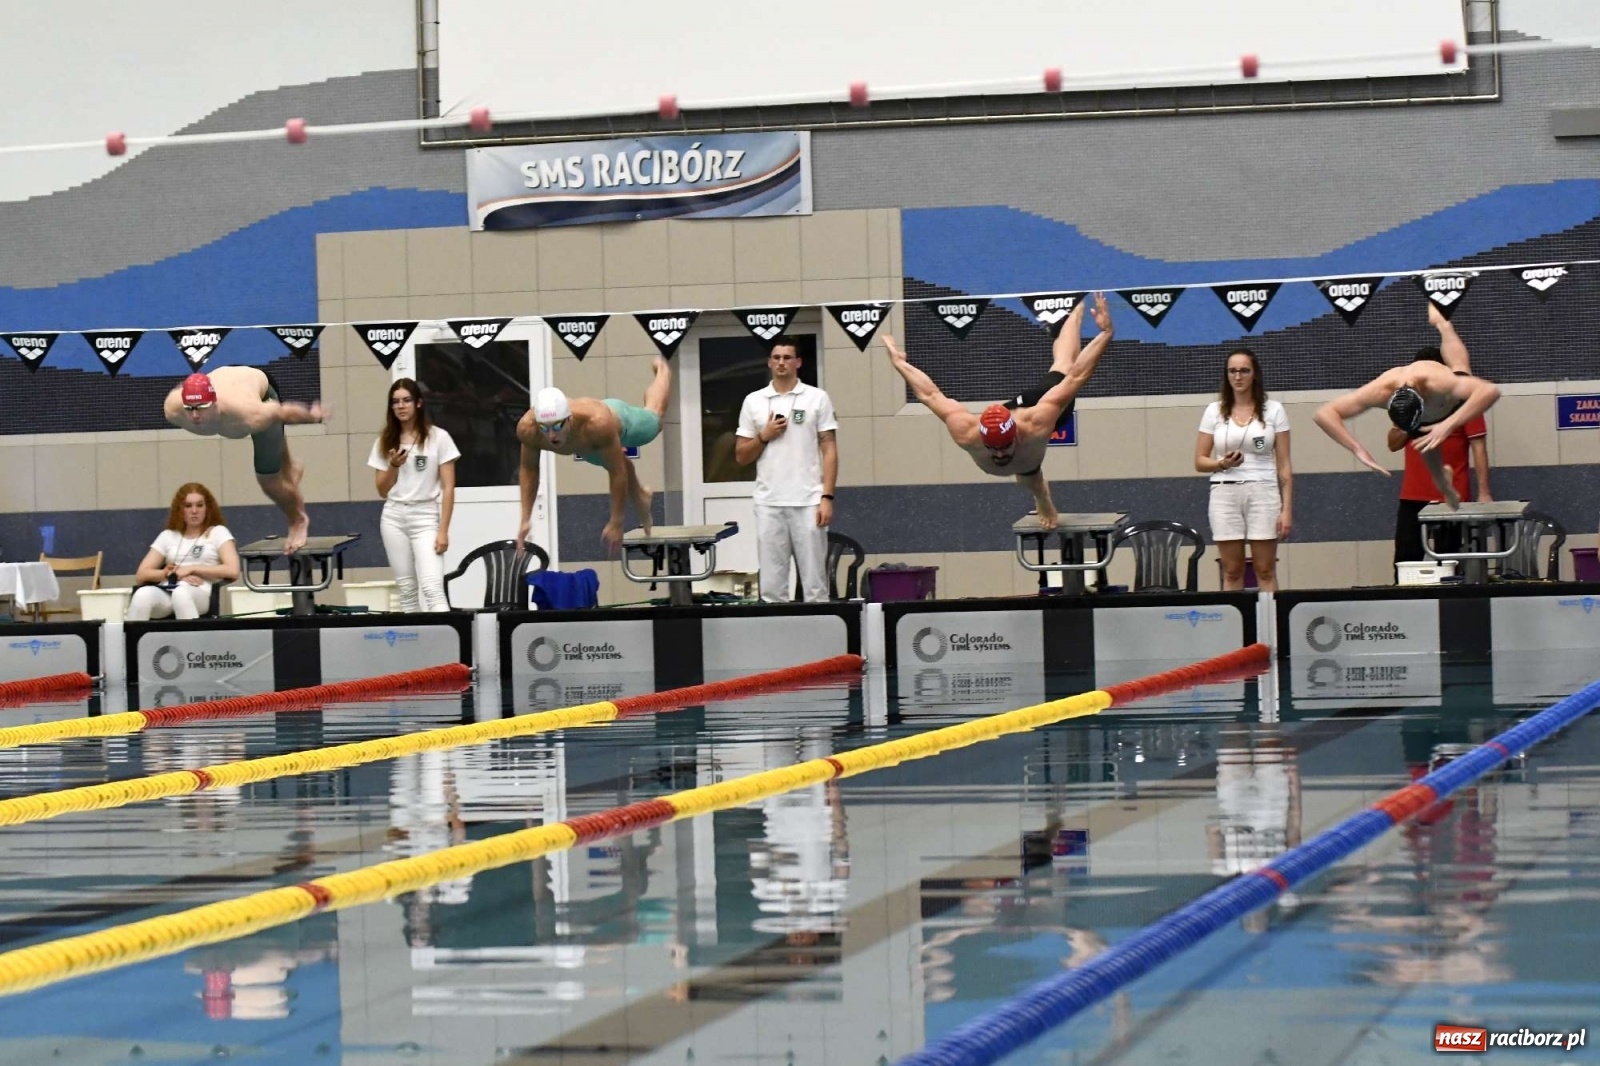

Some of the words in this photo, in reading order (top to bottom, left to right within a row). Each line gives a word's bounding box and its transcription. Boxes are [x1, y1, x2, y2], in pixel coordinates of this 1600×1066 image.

[520, 156, 585, 188] SMS
[592, 142, 745, 187] RACIBÓRZ
[1522, 266, 1564, 280] arena
[1329, 282, 1370, 298] arena
[1425, 276, 1466, 291] arena
[1131, 291, 1171, 303] arena
[1227, 289, 1267, 302] arena
[938, 304, 977, 315] arena
[1034, 296, 1074, 310] arena
[747, 313, 785, 325] arena
[841, 309, 880, 322] arena
[460, 323, 498, 336] arena
[558, 321, 596, 334] arena
[649, 318, 687, 331] arena
[181, 331, 220, 347] arena
[276, 327, 314, 338] arena
[367, 328, 405, 341] arena
[12, 336, 47, 348] arena
[95, 337, 132, 349] arena
[1345, 633, 1366, 641] TIME
[1368, 633, 1406, 641] SYSTEMS
[973, 643, 1011, 651] SYSTEMS
[564, 653, 584, 661] TIME
[587, 652, 622, 662] SYSTEMS
[209, 661, 243, 669] SYSTEMS
